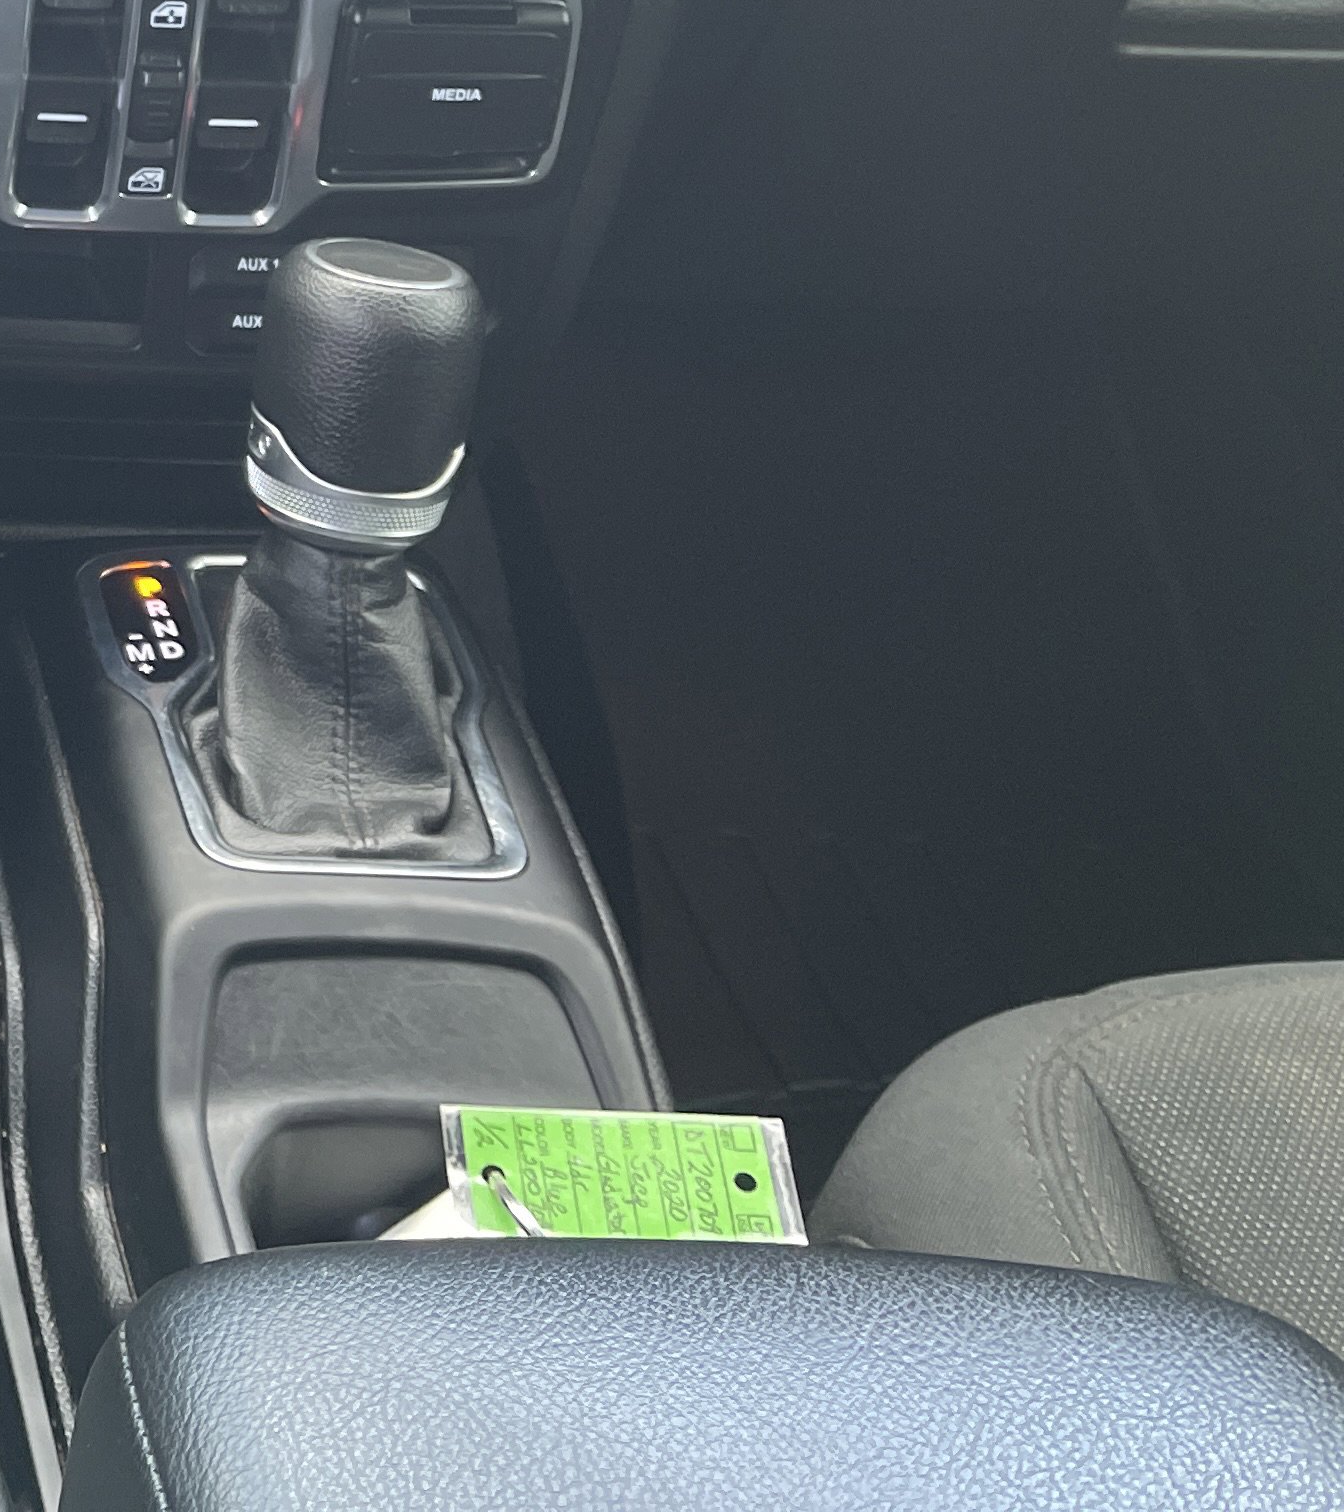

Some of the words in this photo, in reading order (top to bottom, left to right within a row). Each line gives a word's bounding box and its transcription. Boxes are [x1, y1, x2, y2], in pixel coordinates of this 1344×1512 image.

[432, 88, 483, 104] MEDIA
[237, 257, 269, 272] AUX
[232, 314, 263, 329] AUX
[145, 598, 171, 617] R
[151, 618, 179, 638] N
[125, 642, 157, 662] M
[159, 640, 186, 660] D
